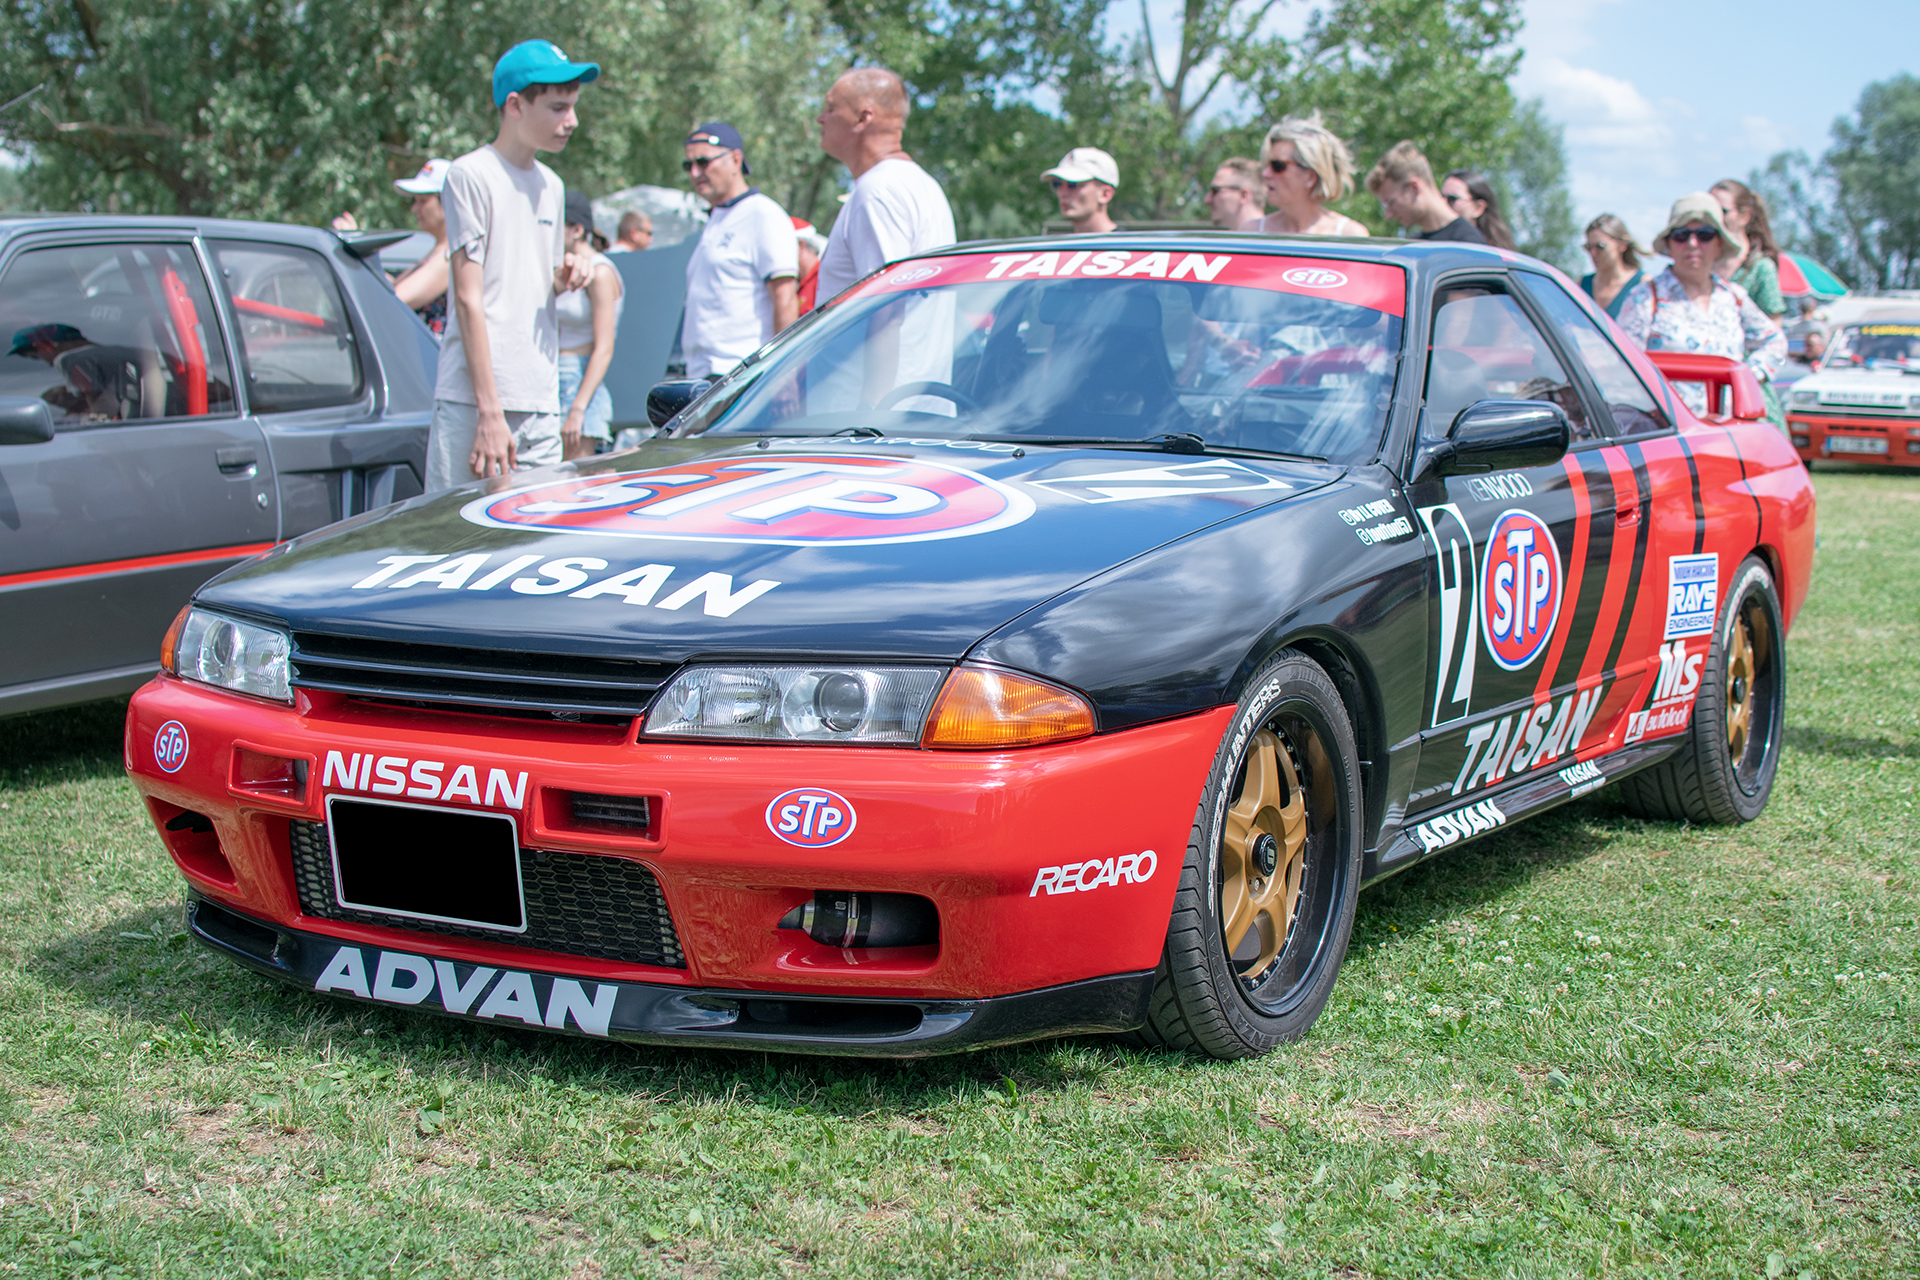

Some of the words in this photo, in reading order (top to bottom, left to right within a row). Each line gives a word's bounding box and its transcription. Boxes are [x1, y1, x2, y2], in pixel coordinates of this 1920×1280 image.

[894, 266, 938, 284] STP
[985, 250, 1232, 282] TAISAN
[1293, 268, 1340, 285] STP
[771, 437, 1020, 452] KENWOOD
[515, 460, 948, 525] STP
[1462, 473, 1533, 502] KENWOOD
[351, 553, 782, 619] TAISAN
[1492, 525, 1552, 645] STP
[1671, 583, 1716, 614] RAYS
[1416, 503, 1478, 729] 2
[1669, 614, 1714, 630] ENGINEERING
[157, 726, 184, 765] STP
[1451, 685, 1604, 797] TAISAN
[322, 750, 529, 810] NISSAN
[1558, 759, 1603, 787] TAISAN
[777, 794, 844, 838] STP
[1417, 798, 1506, 855] ADVAN
[1029, 850, 1158, 898] RECARO
[314, 946, 619, 1037] ADVAN
